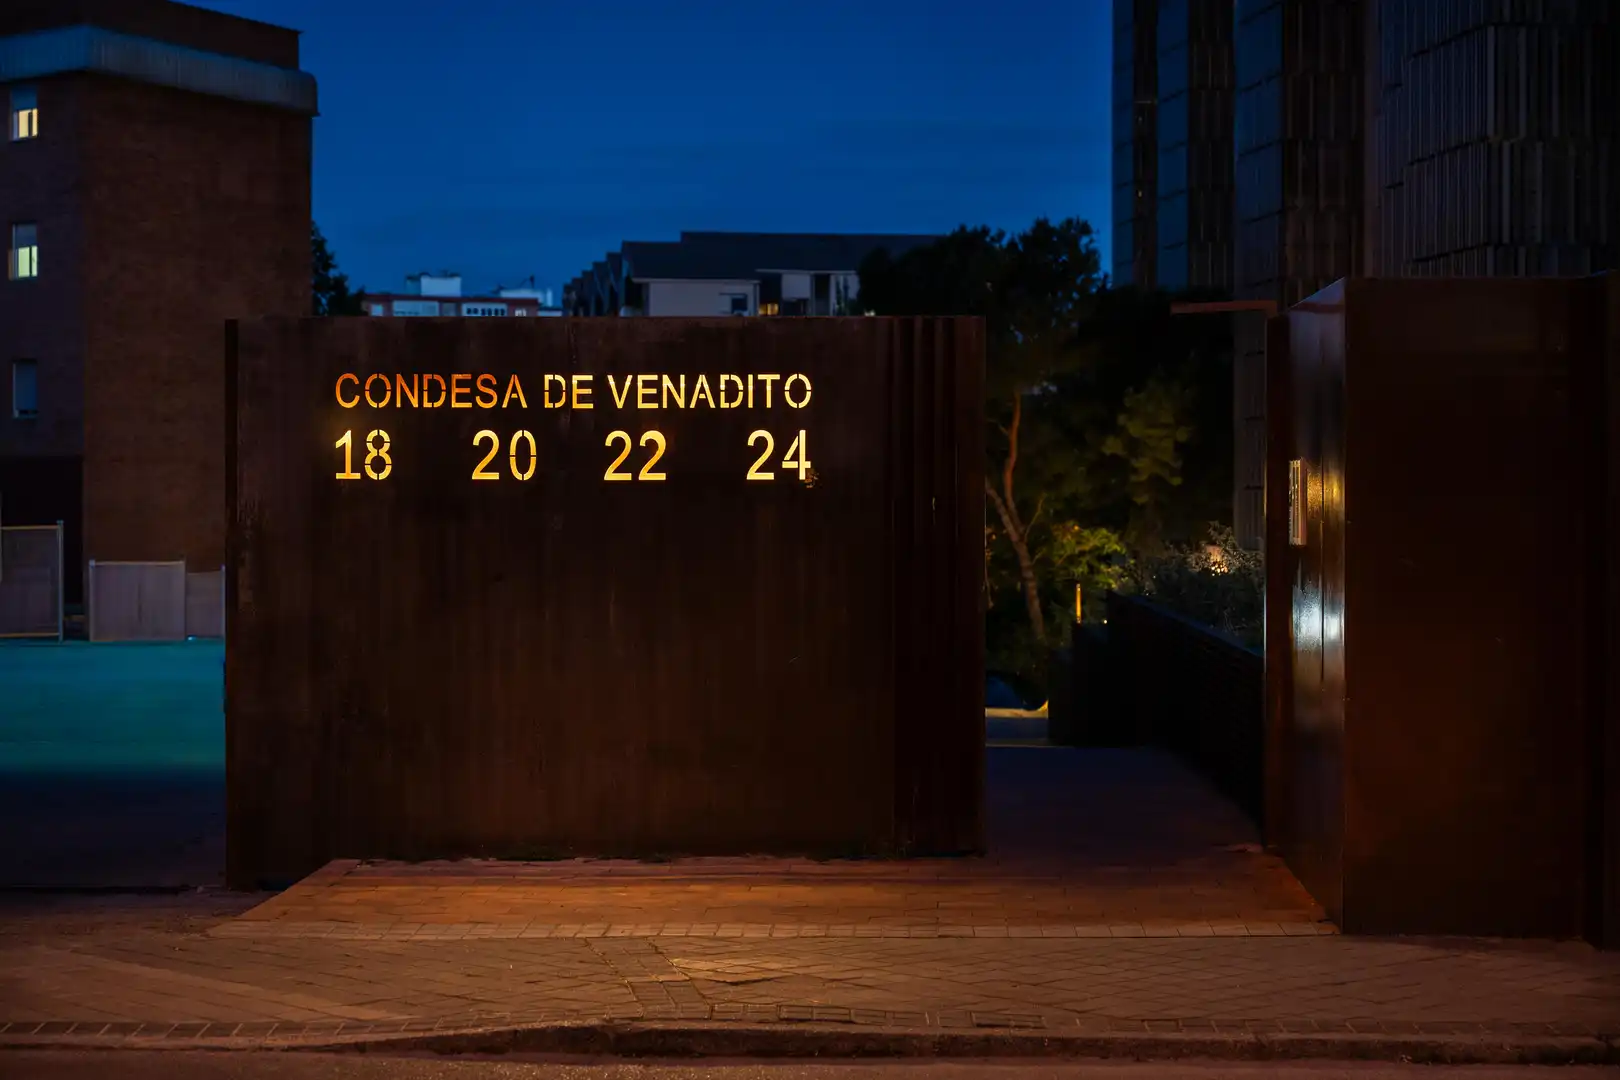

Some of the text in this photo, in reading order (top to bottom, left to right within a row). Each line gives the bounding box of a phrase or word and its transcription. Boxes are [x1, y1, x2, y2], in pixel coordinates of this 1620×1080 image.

[335, 373, 812, 409] CONDESA DE VENADITO
[335, 429, 812, 481] 18 20 22 24
